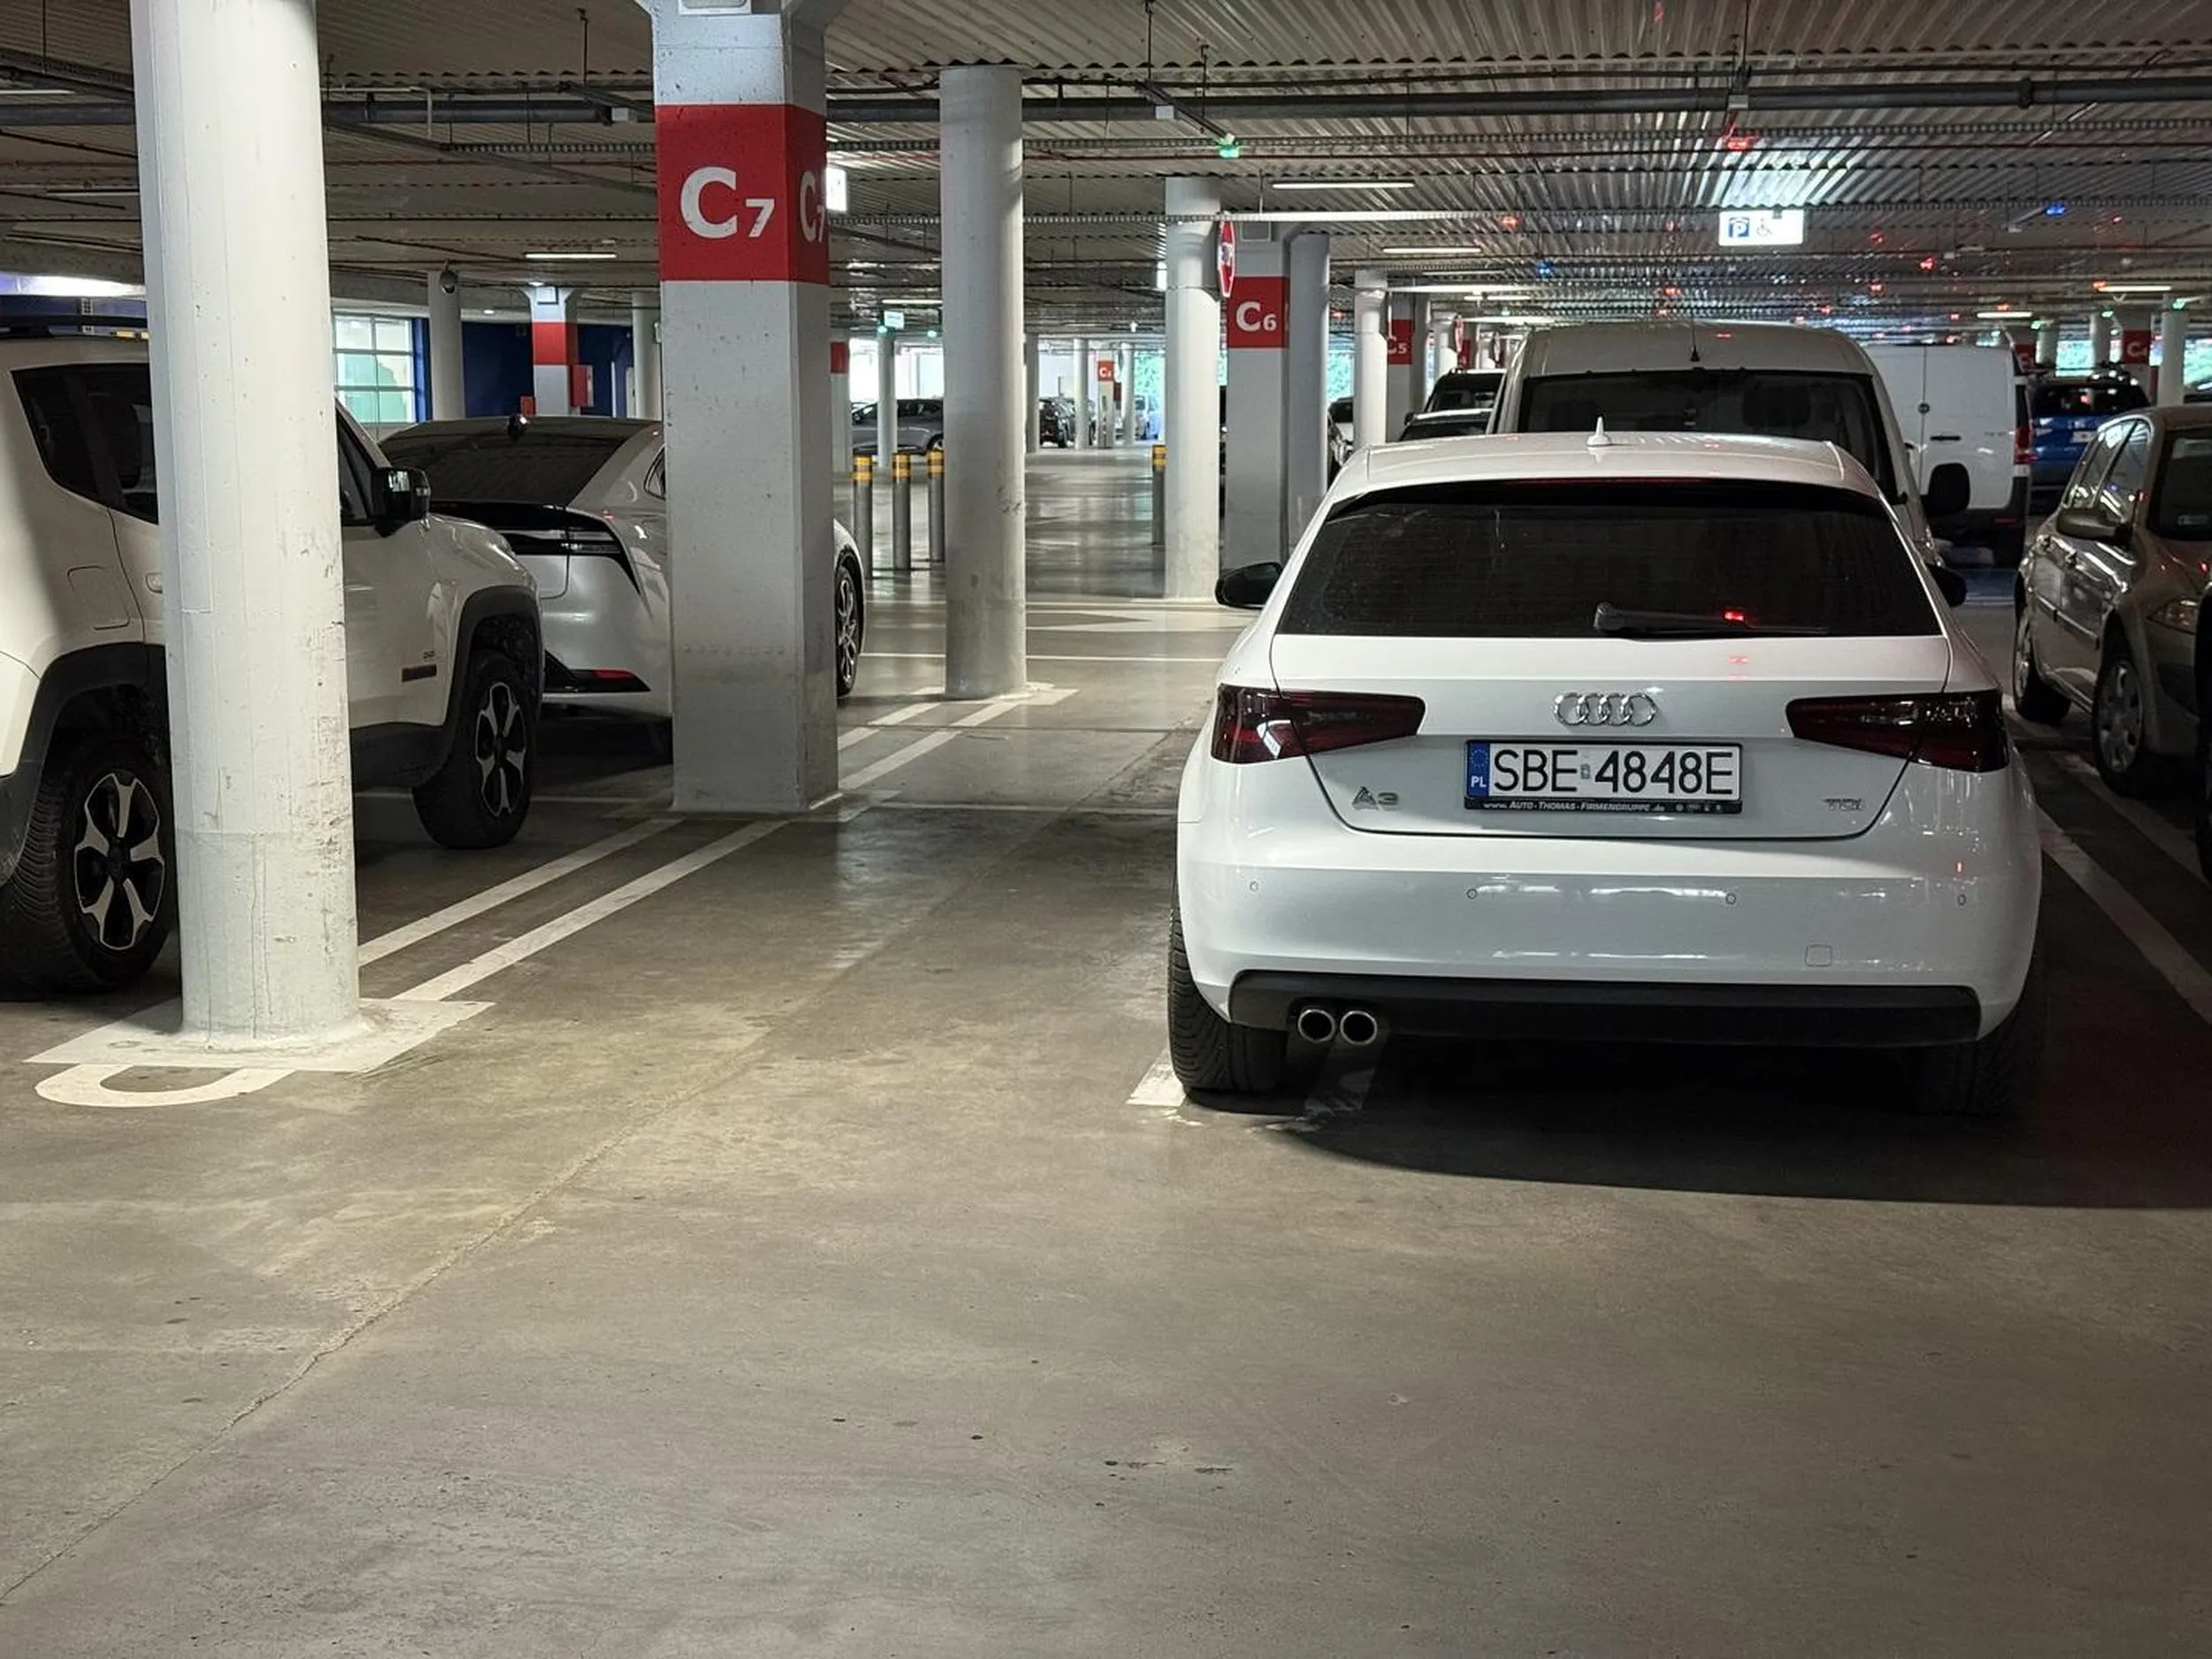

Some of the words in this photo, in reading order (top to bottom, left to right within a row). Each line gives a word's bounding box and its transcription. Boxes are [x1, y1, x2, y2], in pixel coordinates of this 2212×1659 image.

[680, 165, 775, 239] C7
[1236, 301, 1277, 333] C6
[1471, 775, 1486, 787] PL
[1494, 749, 1578, 792] SBE
[1594, 750, 1733, 795] 4848E
[1352, 786, 1399, 809] A3
